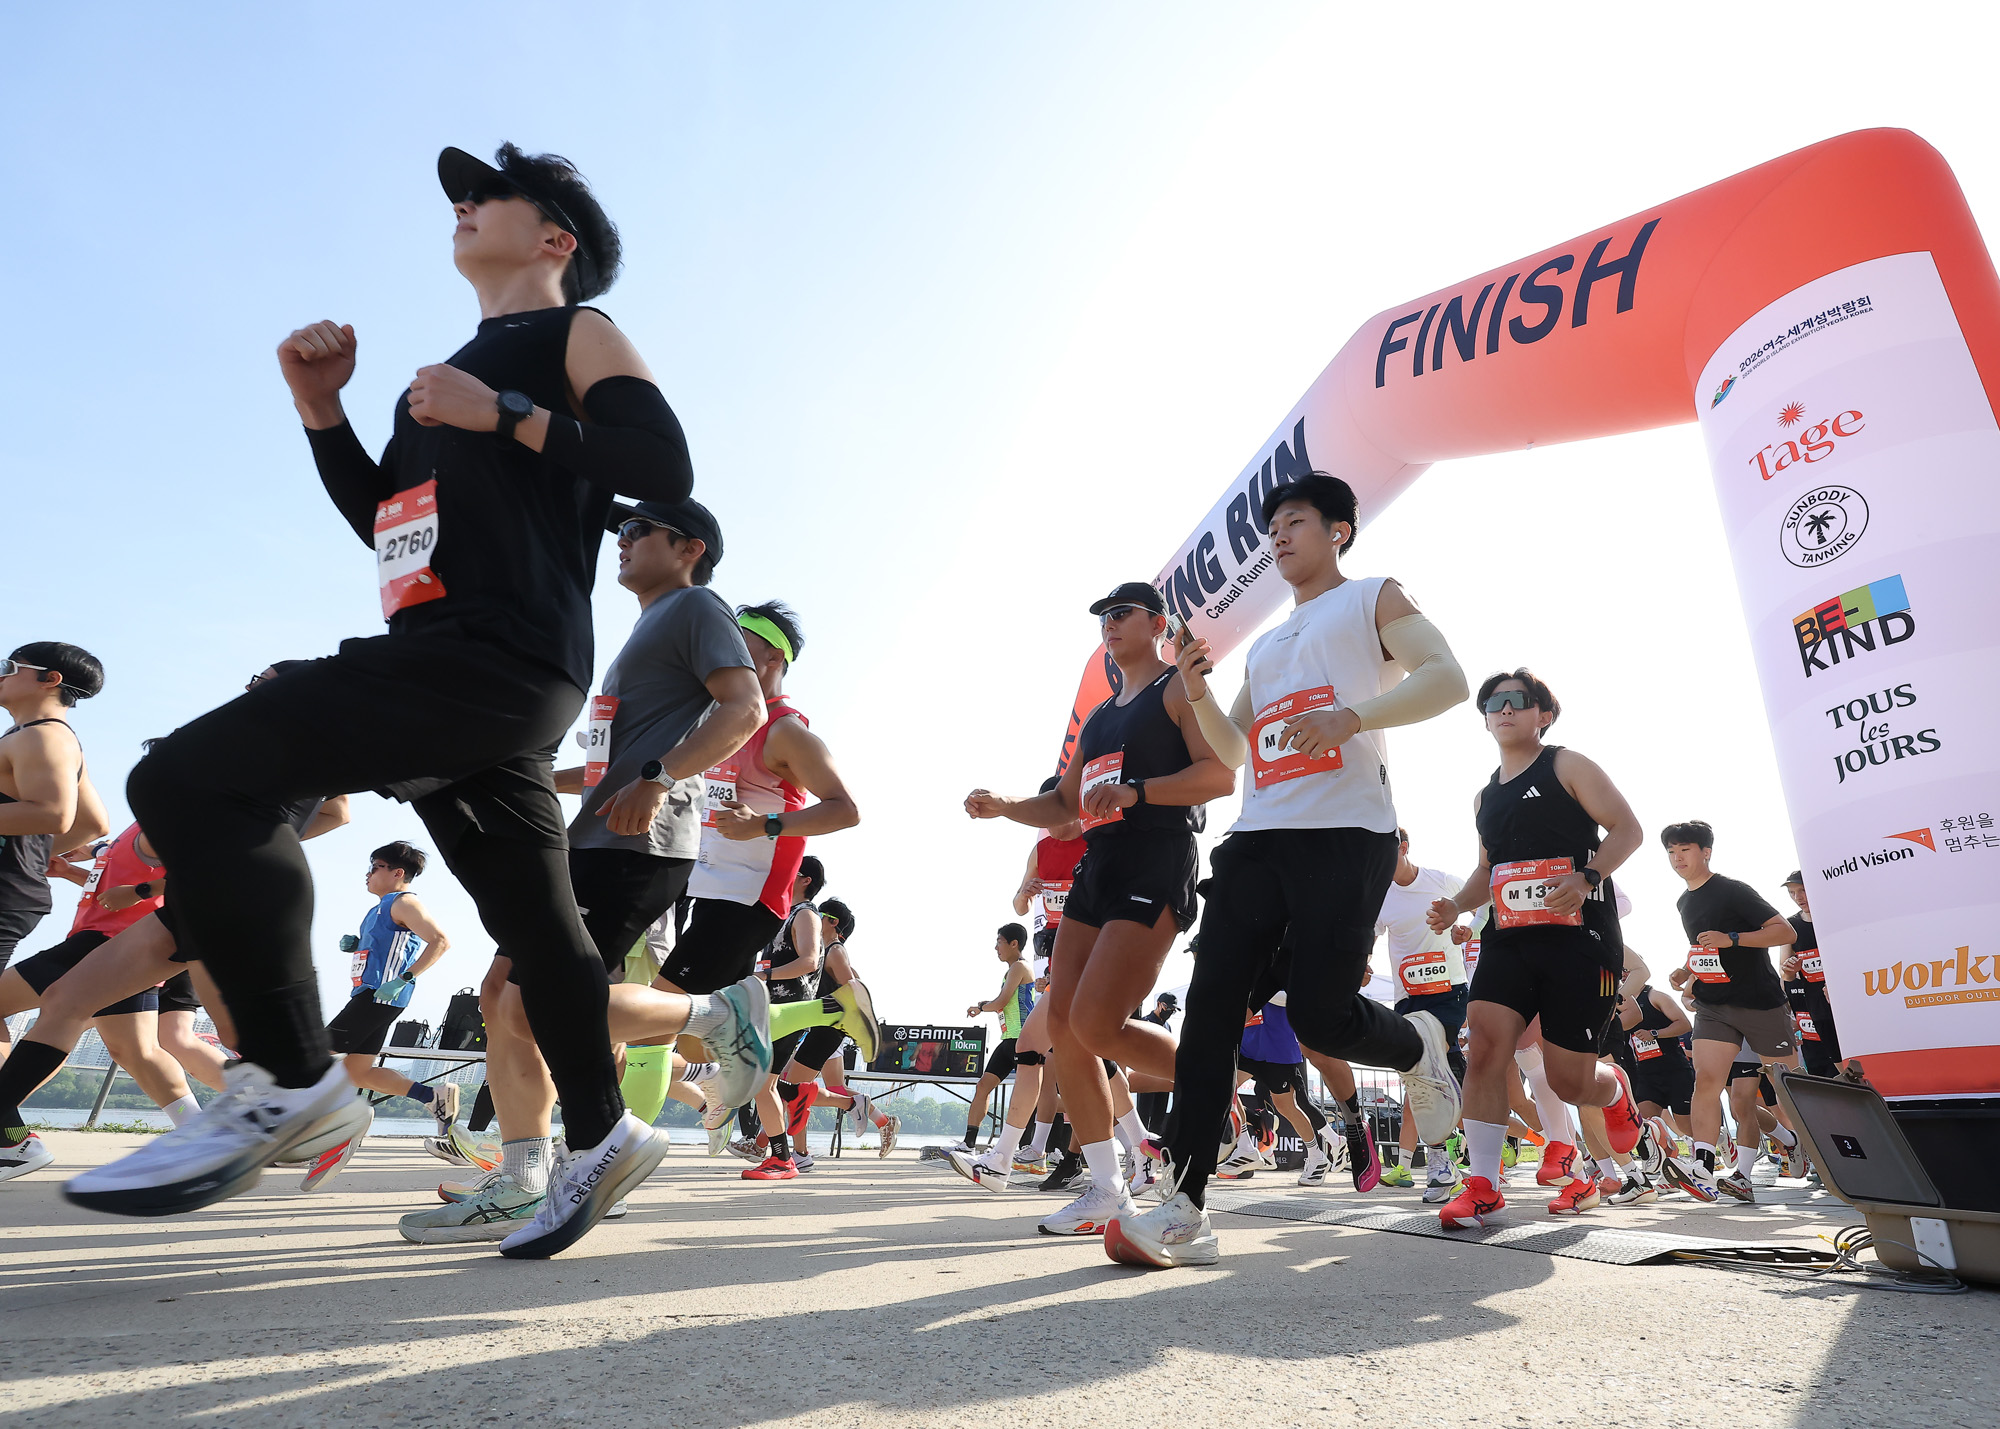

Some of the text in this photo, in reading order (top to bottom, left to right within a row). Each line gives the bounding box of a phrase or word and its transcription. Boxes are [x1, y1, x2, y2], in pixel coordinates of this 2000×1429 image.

[1376, 217, 1662, 388] FINISH
[1752, 354, 1771, 370] WORLD
[1770, 341, 1791, 357] ISLAND
[1791, 324, 1826, 344] EXHIBITION
[1825, 314, 1849, 327] YEOSU
[1850, 306, 1874, 317] KOREA
[1749, 410, 1866, 481] Tage
[1786, 490, 1851, 529] SUNBODY
[384, 526, 433, 562] 2760
[1802, 532, 1856, 563] TANNING
[1206, 584, 1244, 619] Casual
[1801, 611, 1916, 678] KIND
[1308, 692, 1329, 702] 10km
[1826, 683, 1917, 730] TOUS
[1264, 734, 1276, 748] M
[1860, 720, 1890, 744] les
[1833, 728, 1941, 784] JOURS
[707, 785, 733, 801] 2483
[1940, 812, 1995, 834] 후원을
[1944, 833, 2000, 853] 멈추는
[1522, 865, 1537, 873] RUN
[1822, 847, 1915, 881] World Vision
[1508, 890, 1520, 900] M
[1418, 965, 1446, 977] 1560
[1698, 958, 1718, 967] 3651
[1907, 993, 1960, 1006] OUTDOOR
[908, 1028, 964, 1040] SAMIK
[954, 1041, 977, 1050] 10km
[1844, 1139, 1852, 1150] 3
[569, 1144, 621, 1206] DESCENTE
